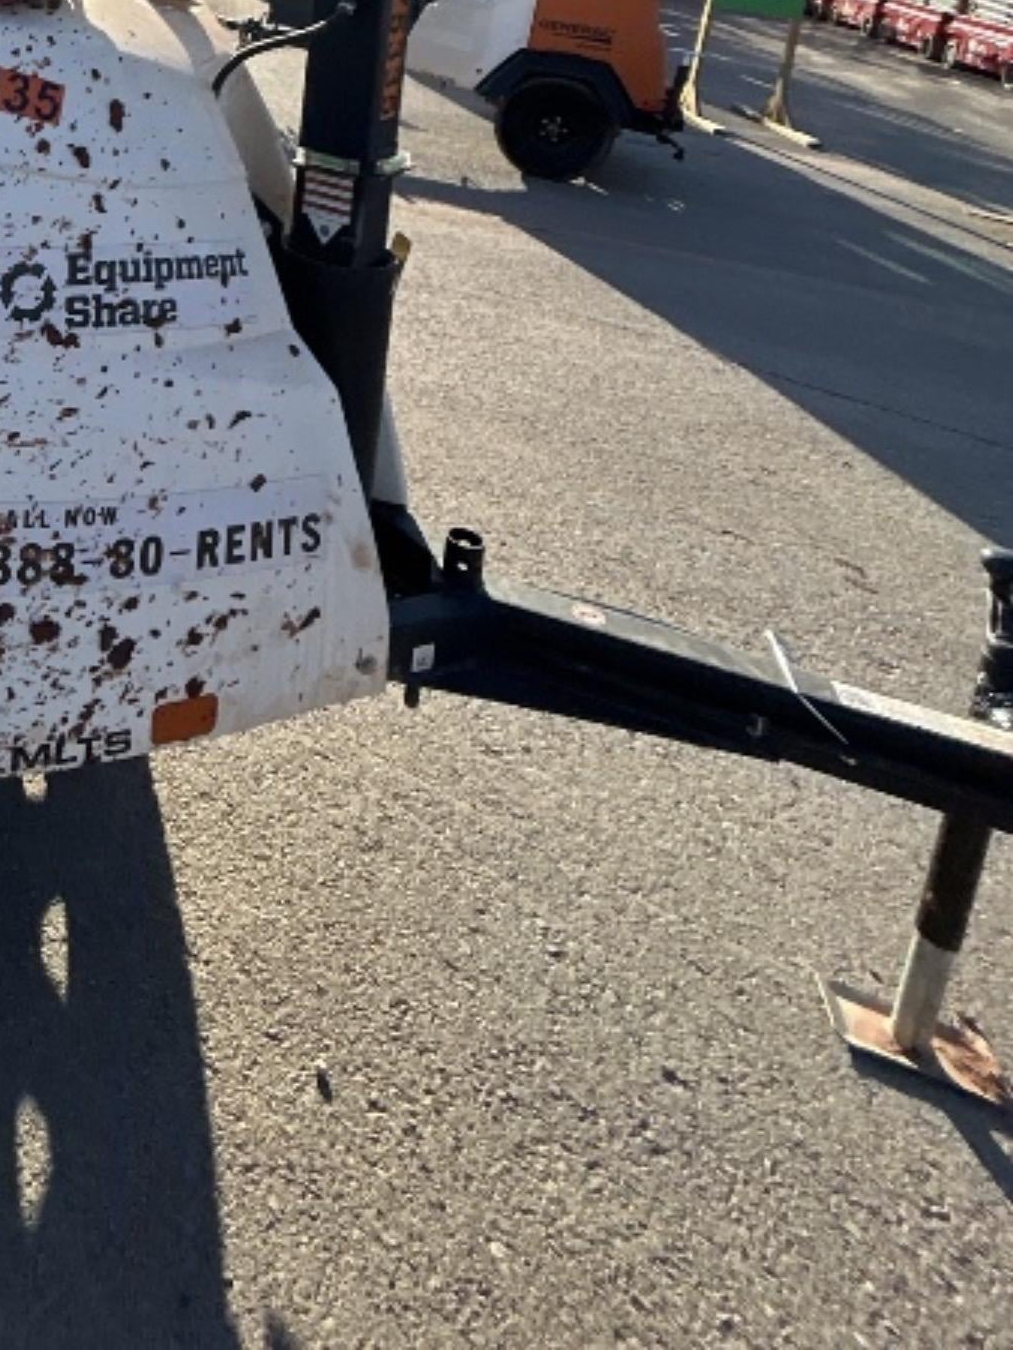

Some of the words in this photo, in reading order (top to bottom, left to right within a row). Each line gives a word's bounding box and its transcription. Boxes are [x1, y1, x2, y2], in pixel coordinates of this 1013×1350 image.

[64, 250, 249, 290] Equipment
[64, 293, 178, 328] Share
[64, 505, 118, 528] NOW
